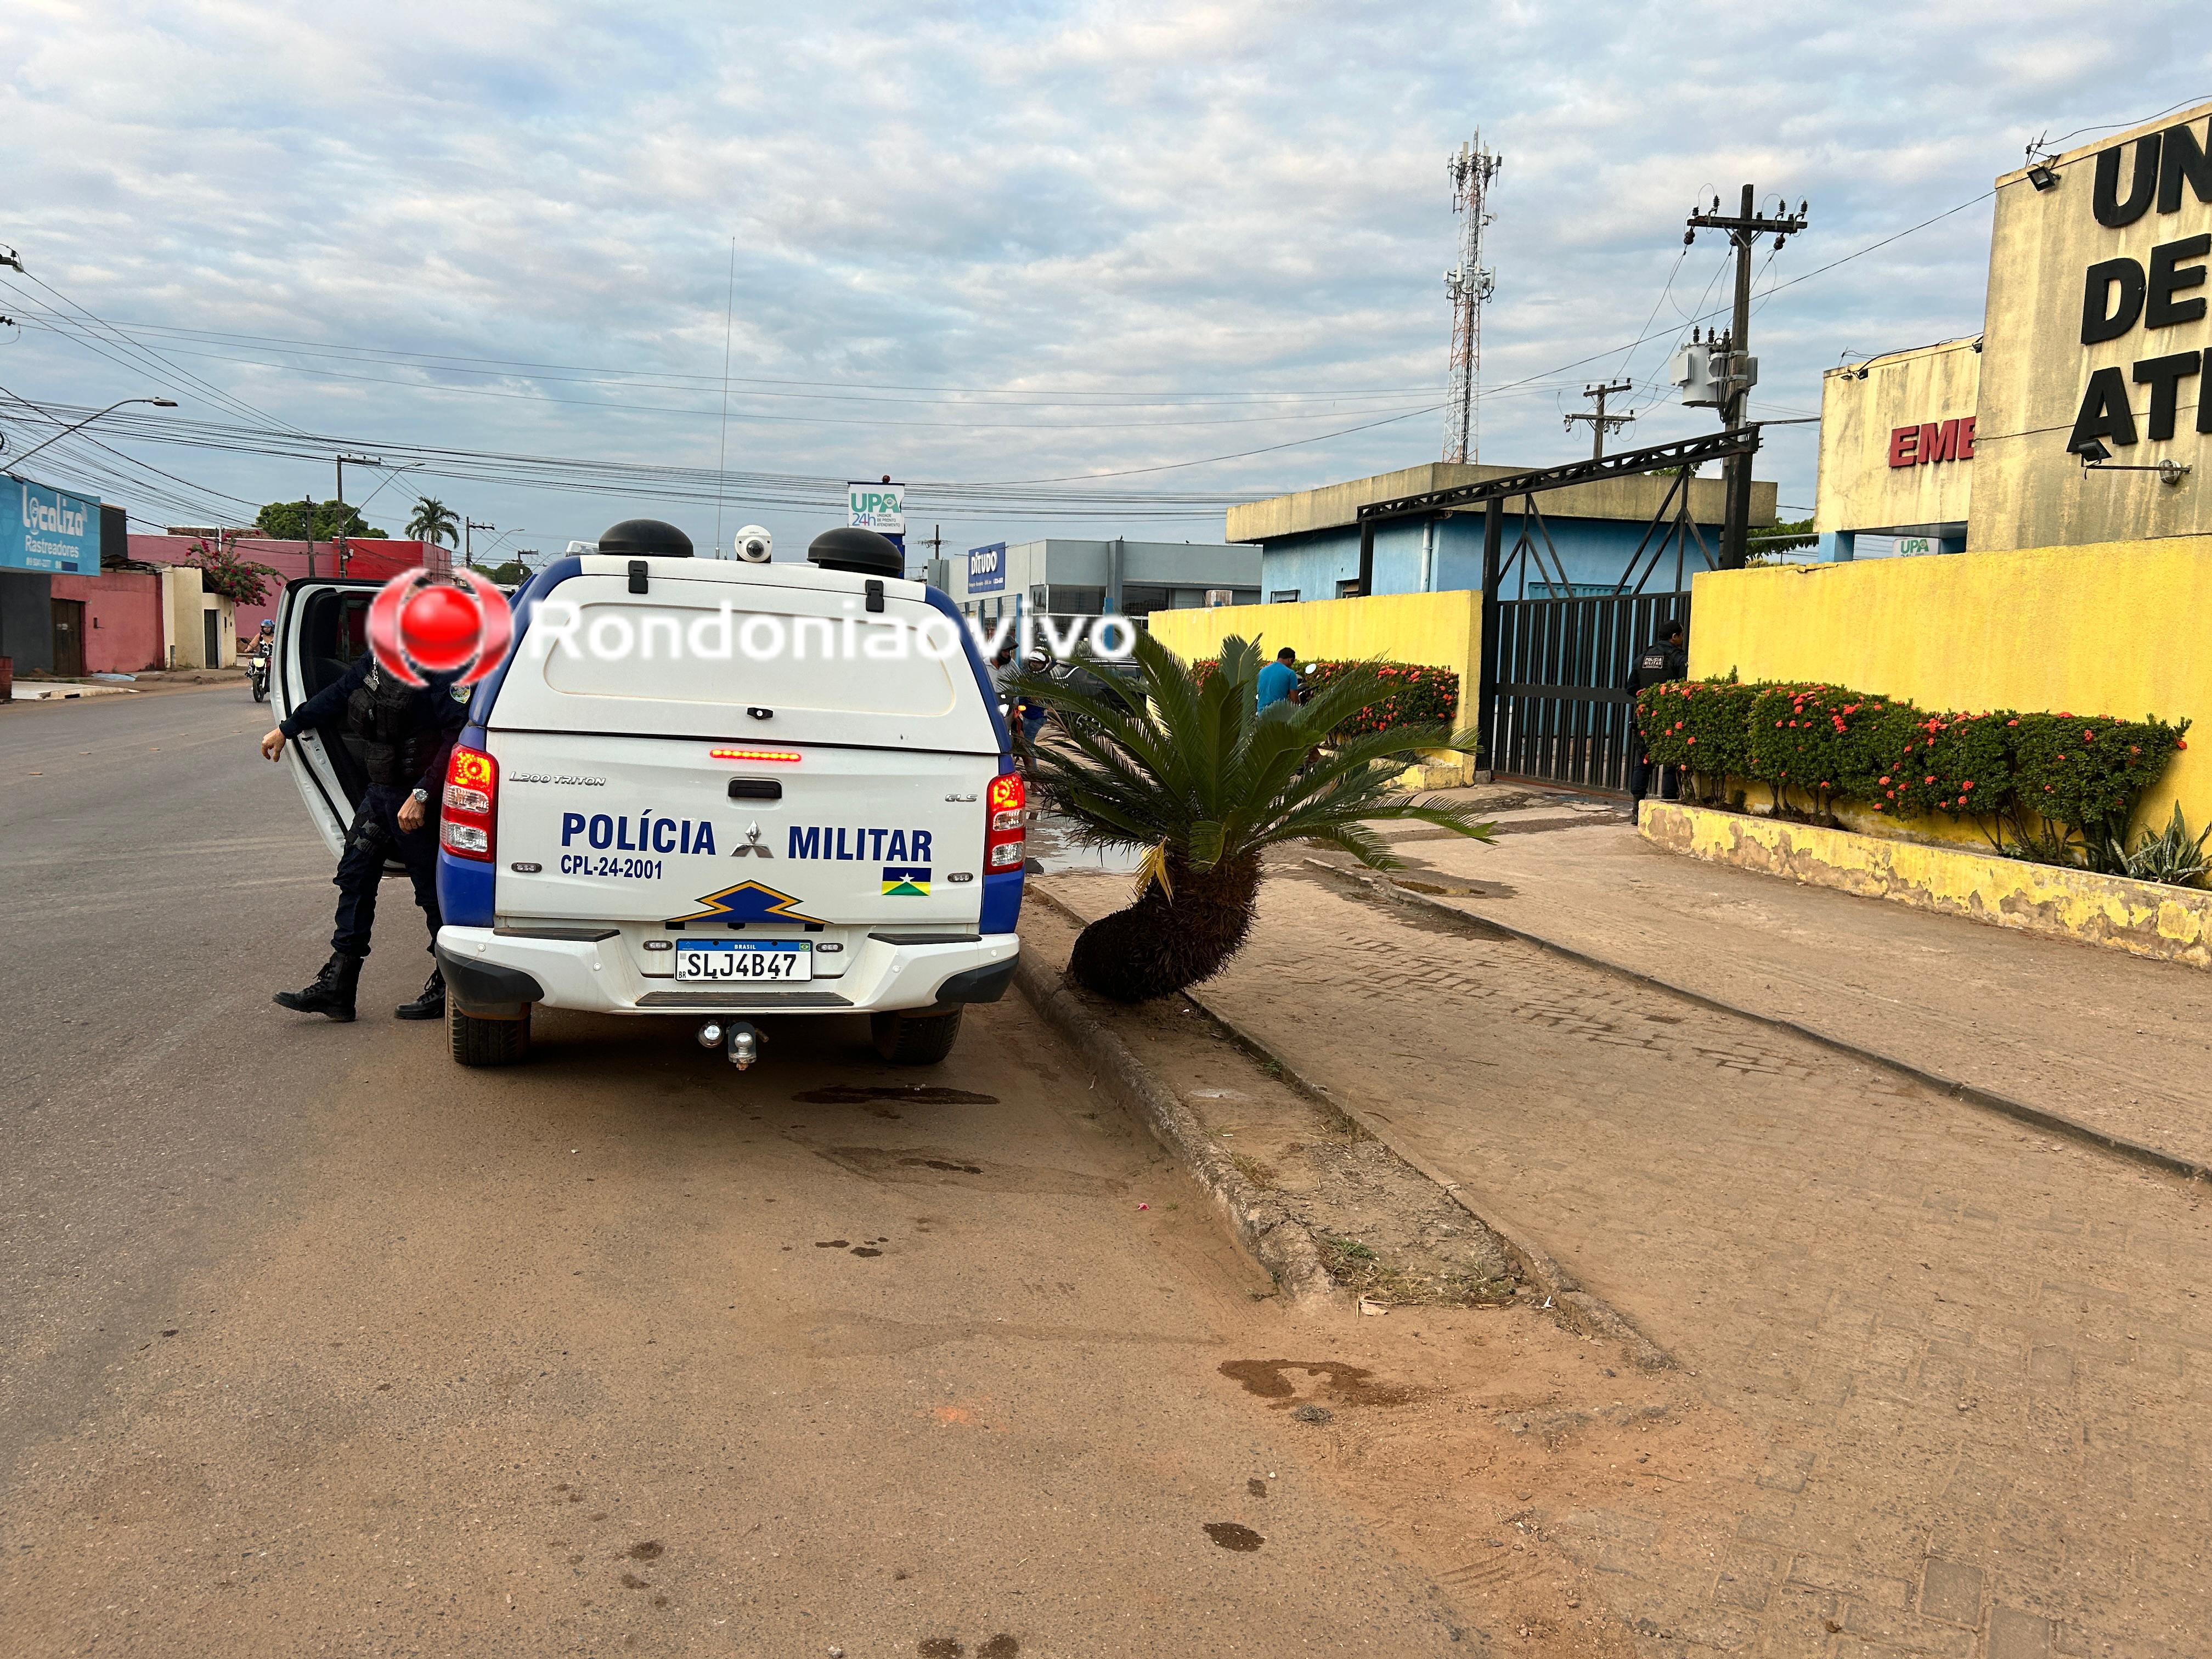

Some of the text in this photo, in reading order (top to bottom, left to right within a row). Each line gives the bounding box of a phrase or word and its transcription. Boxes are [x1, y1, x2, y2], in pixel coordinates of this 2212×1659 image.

[2093, 116, 2212, 228] UN
[2081, 233, 2211, 345] DE
[2066, 347, 2212, 453] AT
[851, 493, 900, 513] UPA
[852, 513, 876, 526] 24h
[25, 535, 79, 558] Rastreadores
[1900, 539, 1929, 554] UPA
[509, 771, 606, 786] L200 TRITON
[945, 793, 978, 802] GLS
[561, 809, 932, 862] POLÍCIA MILITAR
[561, 854, 662, 879] CPL-24-2001
[687, 953, 797, 977] SLJ4B47
